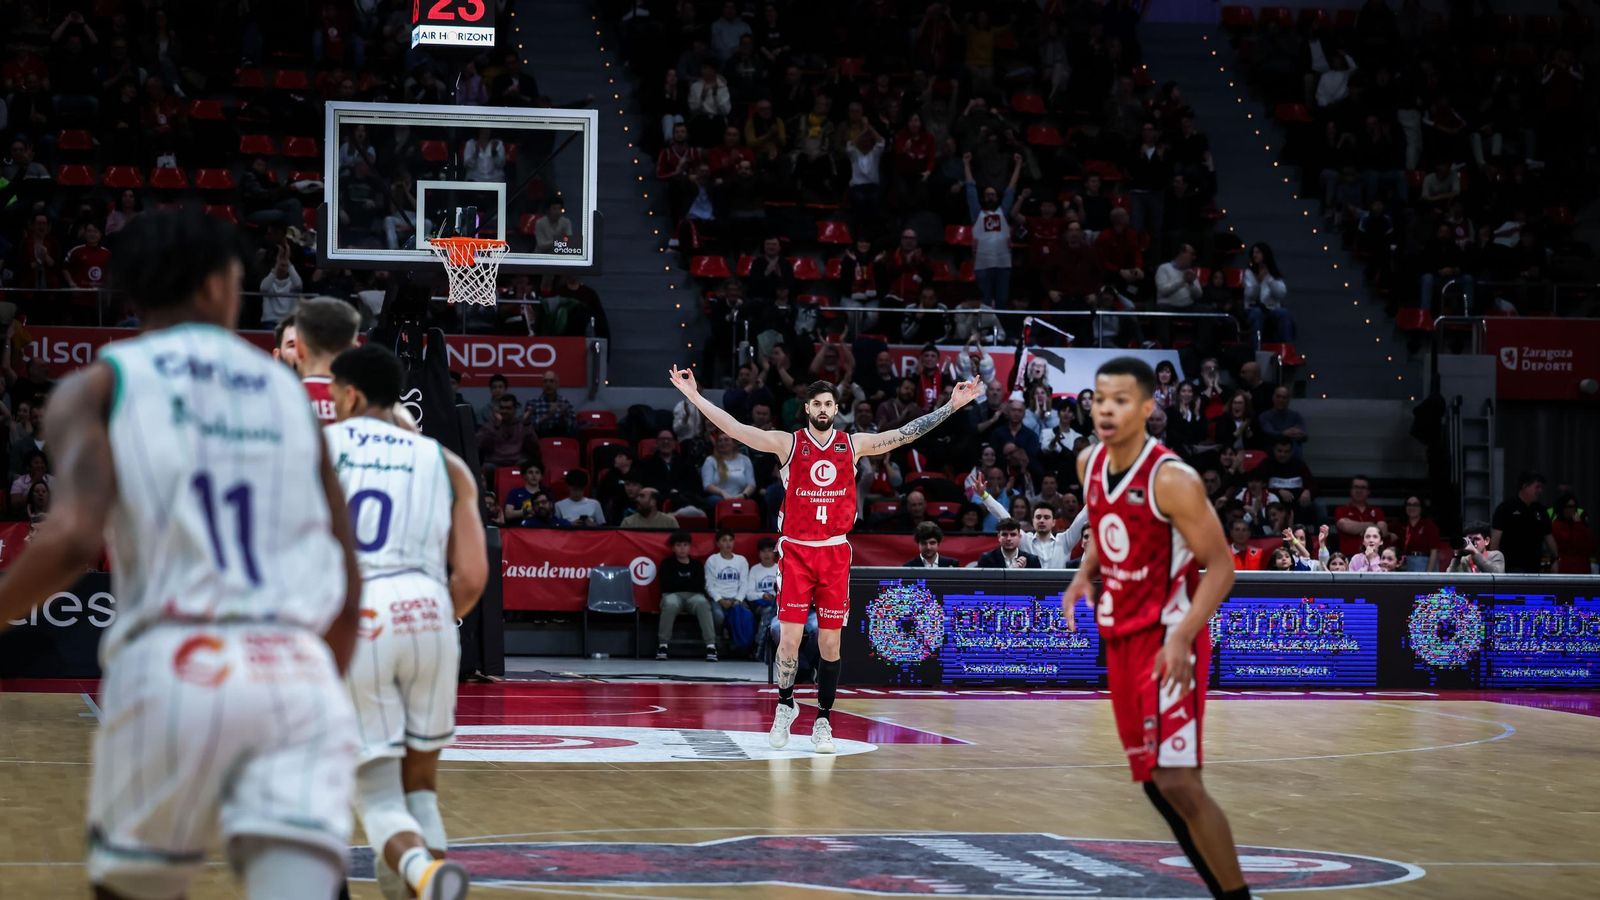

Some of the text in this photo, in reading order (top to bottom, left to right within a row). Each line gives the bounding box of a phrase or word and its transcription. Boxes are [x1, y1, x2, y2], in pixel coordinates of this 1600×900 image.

[421, 32, 437, 40] AIR
[439, 31, 494, 42] HORIZONT
[1521, 346, 1574, 361] Zaragoza
[795, 487, 847, 497] Casademont
[348, 489, 393, 552] 0
[816, 505, 828, 525] 4
[193, 474, 262, 586] 11
